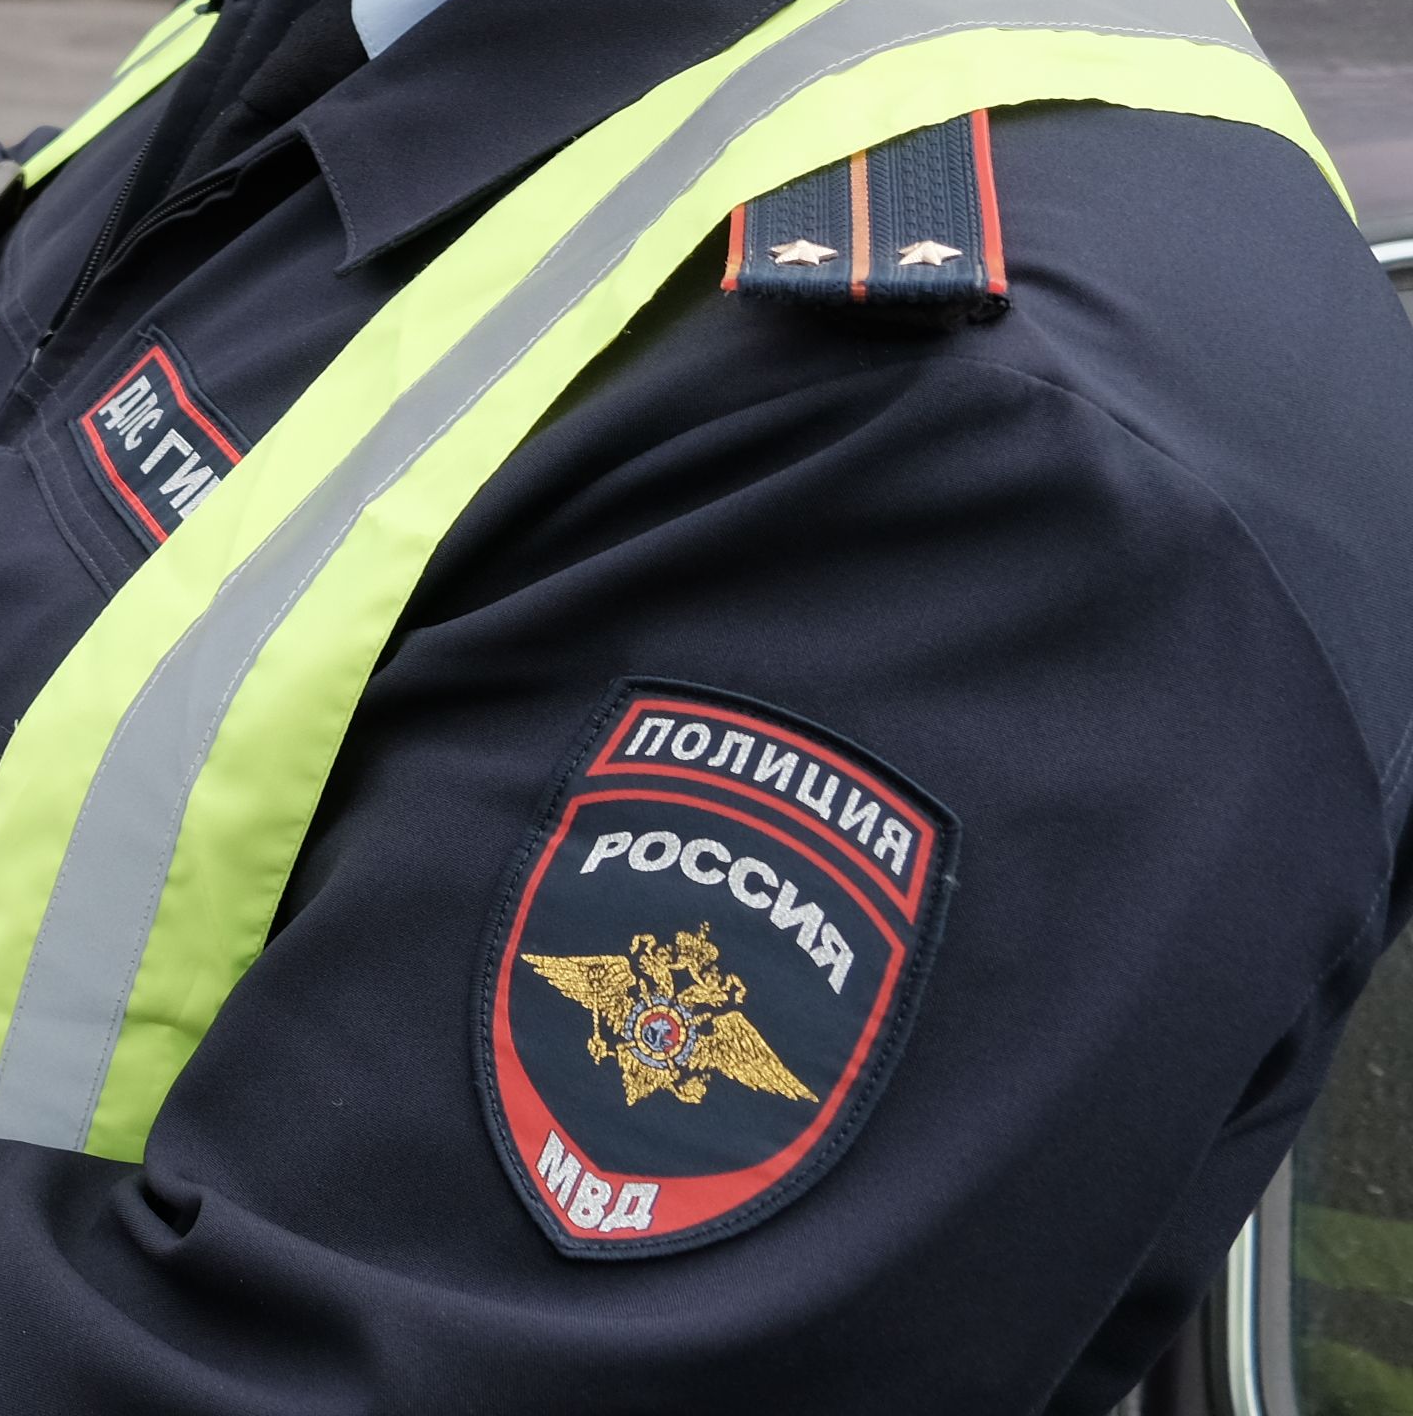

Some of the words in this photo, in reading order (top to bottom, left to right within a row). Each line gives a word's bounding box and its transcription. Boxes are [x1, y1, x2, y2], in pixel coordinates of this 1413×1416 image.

[98, 375, 164, 451] ДПС
[625, 716, 914, 878] ПОЛИЦИЯ
[579, 830, 855, 995] РОССИЯ
[536, 1129, 660, 1234] МВД
